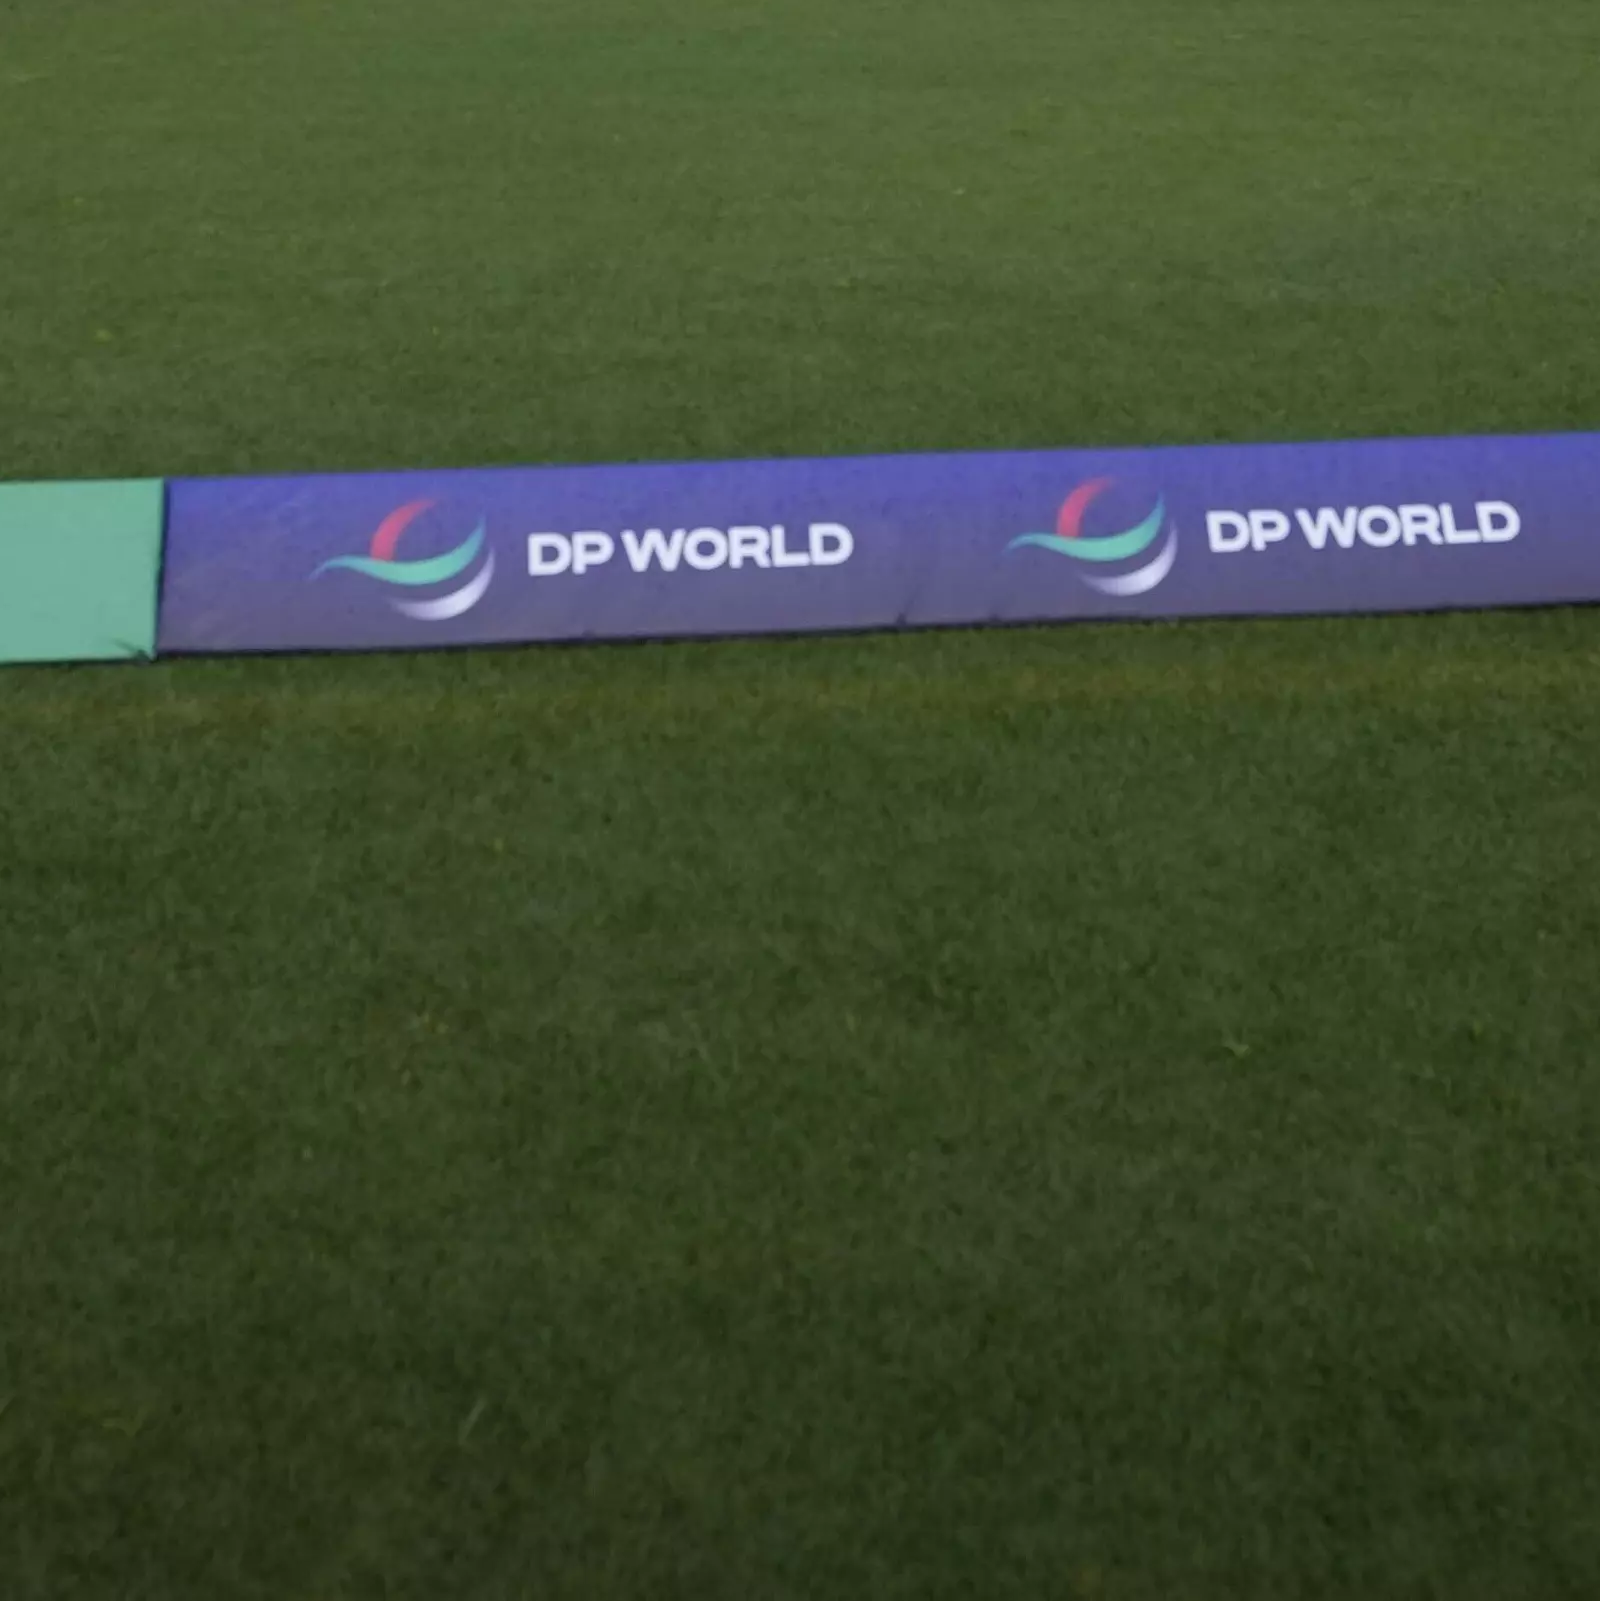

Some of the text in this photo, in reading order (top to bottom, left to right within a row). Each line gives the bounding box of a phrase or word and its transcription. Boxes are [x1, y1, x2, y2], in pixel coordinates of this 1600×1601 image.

[527, 523, 854, 576] DP WORLD
[1206, 500, 1521, 553] DP WORLD
